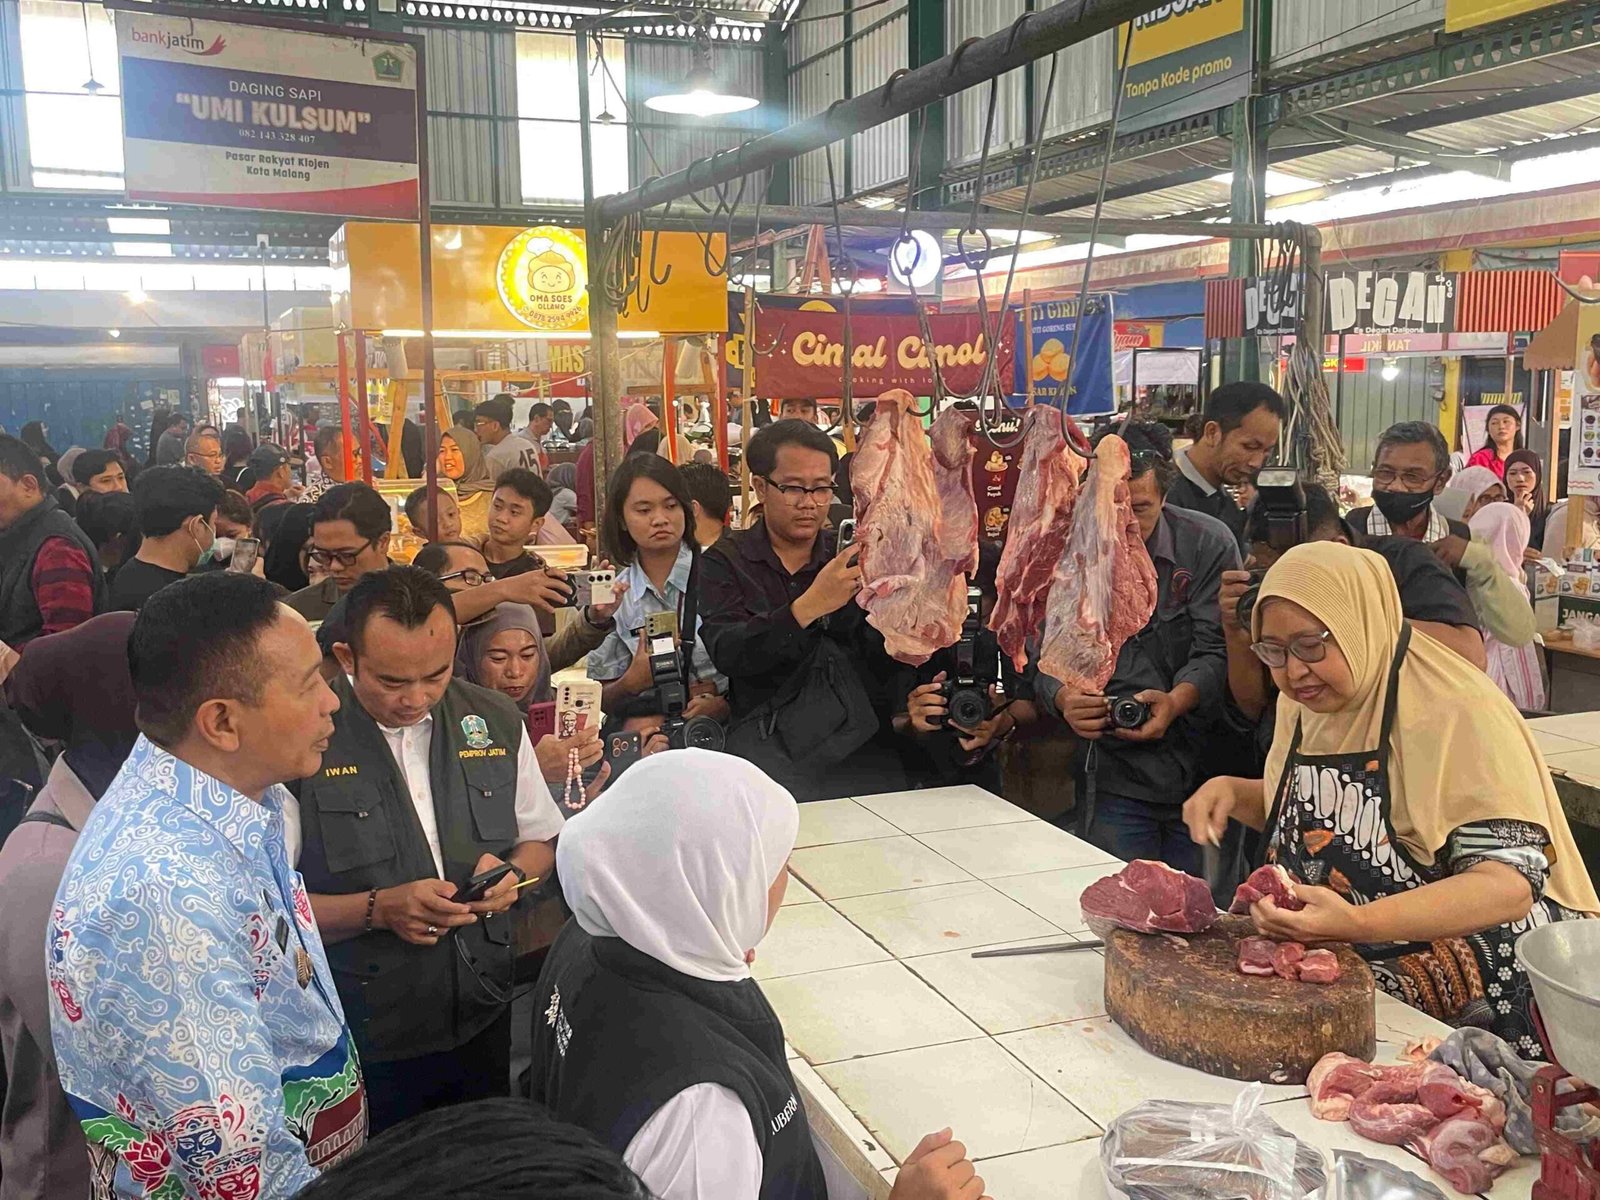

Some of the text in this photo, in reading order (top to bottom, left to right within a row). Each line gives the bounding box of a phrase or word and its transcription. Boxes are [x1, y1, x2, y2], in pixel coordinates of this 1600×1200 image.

[132, 27, 204, 49] bankjatim
[1126, 56, 1232, 98] Tanpa Kode promo
[229, 80, 322, 102] DAGING SAPI
[175, 93, 371, 135] “UMI KULSUM”
[239, 129, 256, 138] 082
[259, 131, 276, 140] 143
[299, 134, 316, 143] 407
[225, 151, 330, 170] Pasar Rakyat Klojen
[246, 165, 310, 181] Kota Malang
[530, 294, 573, 303] OMA SOES
[458, 747, 507, 759] PEMPROV JATIM
[325, 765, 358, 777] IWAN
